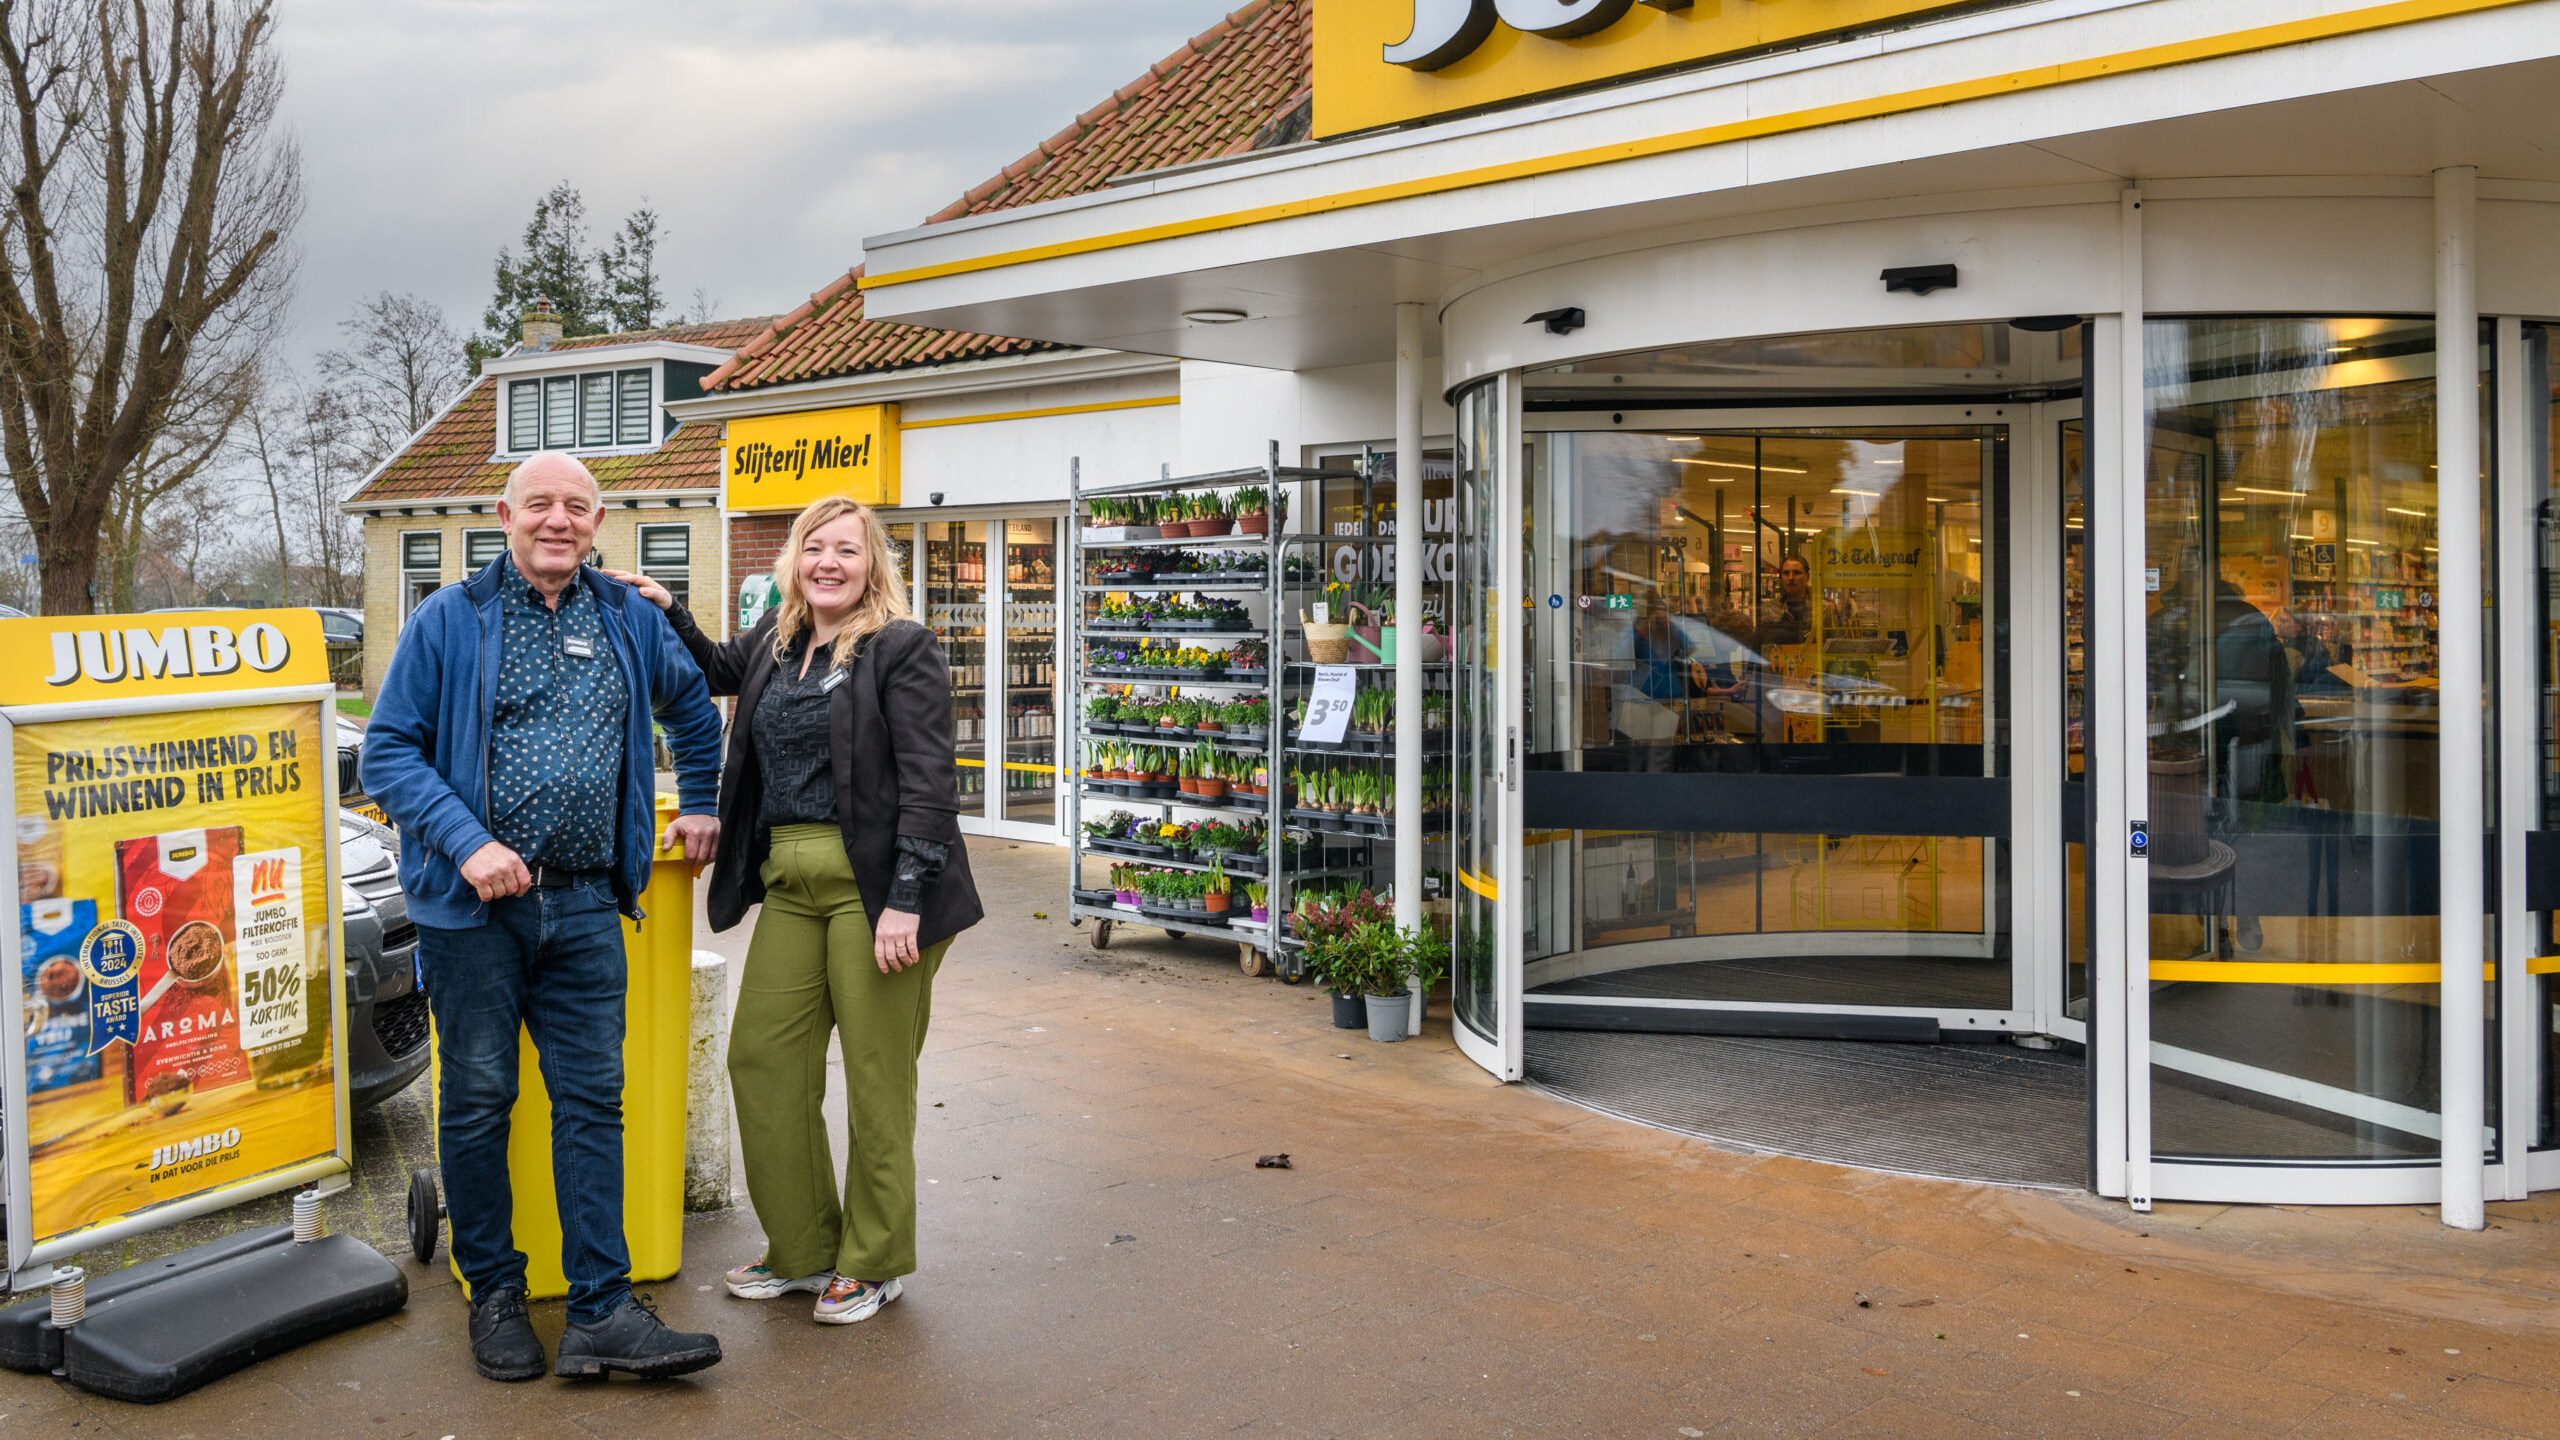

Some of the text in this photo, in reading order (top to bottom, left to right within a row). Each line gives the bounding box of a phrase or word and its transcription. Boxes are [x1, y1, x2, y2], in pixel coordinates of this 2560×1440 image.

[734, 434, 871, 483] Slijterij Mier!
[1378, 520, 1397, 536] DA
[2319, 516, 2330, 532] 9
[1827, 547, 1922, 568] De Telegraaf
[45, 622, 291, 686] JUMBO
[1310, 699, 1349, 726] 3 50
[47, 729, 297, 785] PRIJSWINNEND EN
[44, 761, 301, 821] WINNEND IN PRIJS
[171, 848, 195, 860] JUMBO
[251, 857, 286, 896] nu
[253, 906, 287, 923] JUMBO
[112, 921, 131, 931] TASTE
[242, 917, 299, 939] FILTERKOFFIE
[272, 947, 288, 958] GRAM
[101, 957, 127, 973] 2024
[99, 973, 131, 986] BRUSSELS
[245, 962, 301, 1007] 50%
[94, 996, 137, 1018] TASTE
[100, 990, 130, 1002] SUPERIOR
[105, 1013, 127, 1025] AWARD
[249, 1000, 299, 1027] KORTING
[143, 1007, 234, 1043] AROMA
[156, 1050, 201, 1066] EVENWICHTIG
[209, 1044, 228, 1053] ROND
[148, 1127, 242, 1171] JUMBO
[150, 1149, 240, 1183] EN DAT VOOR DIE PRIJS
